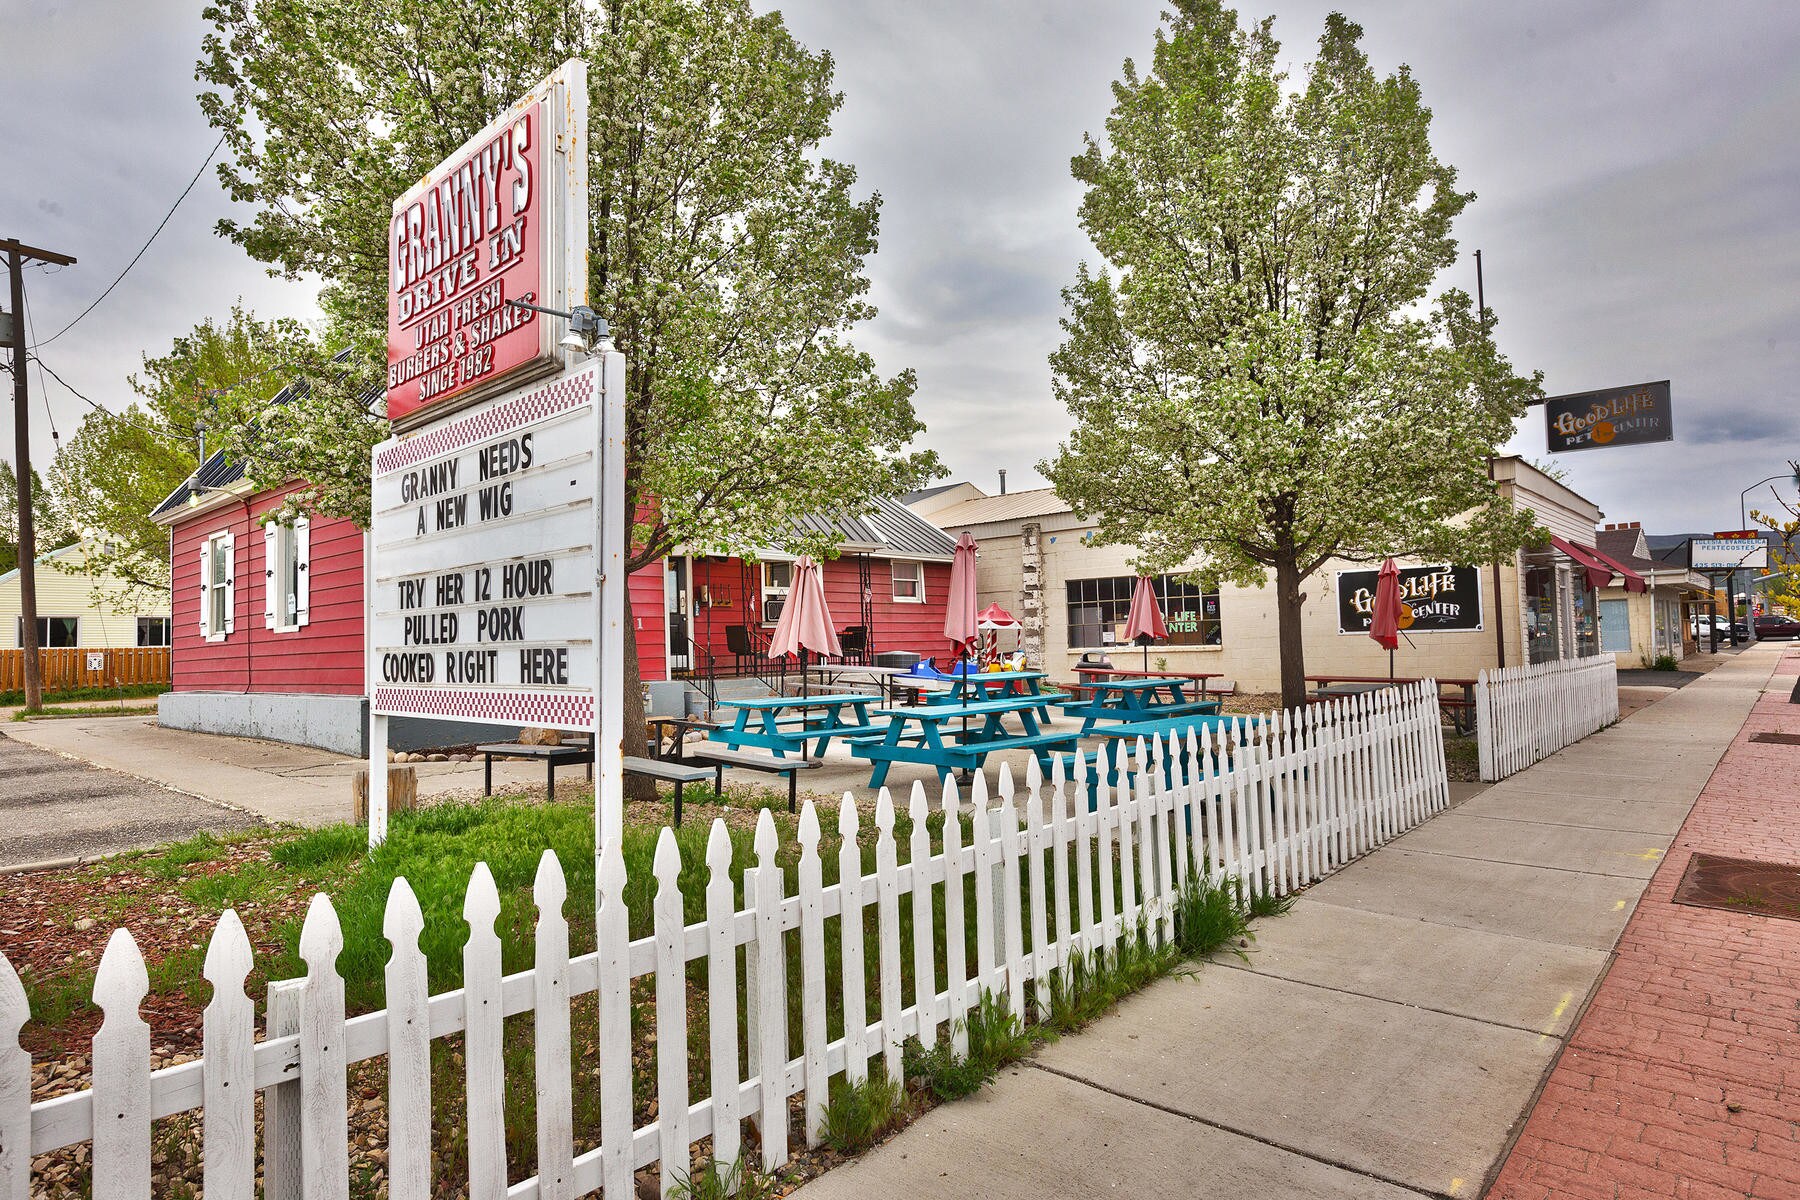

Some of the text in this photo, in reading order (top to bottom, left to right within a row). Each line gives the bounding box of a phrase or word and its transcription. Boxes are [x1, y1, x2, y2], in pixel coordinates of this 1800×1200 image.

[393, 113, 532, 293] GRANNY'S
[398, 215, 528, 326] DRIVE IN
[414, 278, 505, 350] UTAH FRESH
[388, 291, 537, 390] BURGERS & SHAKES
[418, 348, 496, 401] SINCE 1982
[1566, 417, 1660, 446] PET CENTER
[401, 433, 533, 504] GRANNY NEEDS
[417, 482, 512, 536] A NEW WIG
[398, 559, 552, 609] TRY HER 12 HOUR
[1406, 565, 1456, 600] LIFE
[404, 606, 525, 645] PULLED PORK
[1174, 611, 1197, 621] LIFE
[1411, 600, 1460, 618] CENTER
[382, 648, 569, 684] COOKED RIGHT HERE
